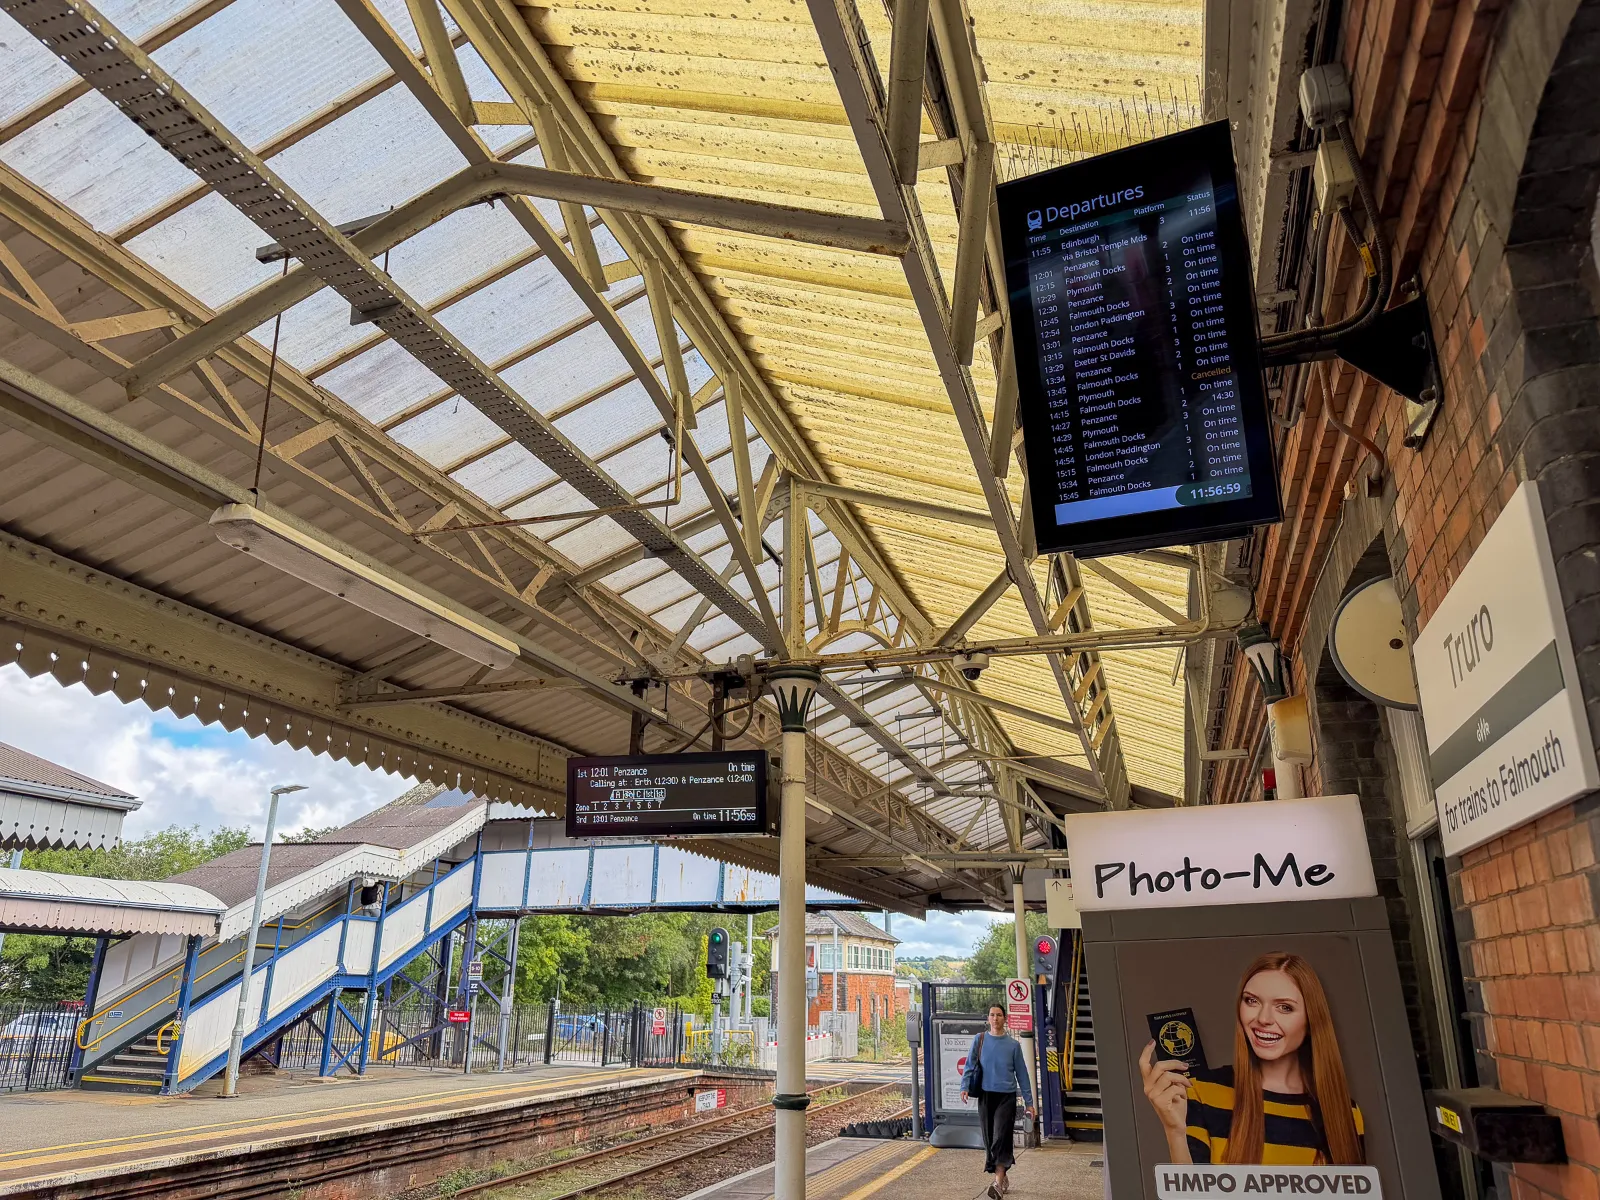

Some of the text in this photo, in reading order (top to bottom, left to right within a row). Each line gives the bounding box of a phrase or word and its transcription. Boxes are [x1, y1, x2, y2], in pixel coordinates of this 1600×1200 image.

[1028, 191, 1210, 243] Time Destination Platform Status
[1046, 185, 1144, 222] Departures
[1031, 246, 1051, 257] 11:55
[1061, 234, 1100, 249] Edinburgh
[1188, 204, 1211, 216] 11:56
[1074, 245, 1099, 258] Bristol
[1100, 239, 1128, 251] Temple
[1130, 234, 1147, 243] Mds
[1034, 270, 1052, 280] 12:01
[1063, 259, 1100, 273] Penzance
[1195, 230, 1214, 240] time
[1035, 281, 1055, 292] 12:15
[1065, 270, 1100, 284] Falmouth
[1102, 265, 1126, 275] Docks
[1196, 243, 1216, 252] time
[1037, 293, 1056, 303] 12:29
[1066, 282, 1102, 297] Plymouth
[1198, 255, 1217, 264] time
[1038, 305, 1058, 315] 12:30
[1067, 295, 1104, 308] Penzance
[1199, 268, 1218, 277] time
[1039, 316, 1059, 327] 12:45
[1069, 306, 1105, 320] Falmouth
[1106, 300, 1130, 311] Docks
[1201, 280, 1220, 289] time
[1040, 328, 1060, 338] 12:54
[1070, 320, 1099, 332] London
[1100, 310, 1145, 325] Paddington
[1202, 292, 1222, 301] time
[1042, 340, 1060, 350] 13:01
[1071, 330, 1108, 343] Penzance
[1204, 305, 1223, 314] time
[1043, 351, 1063, 362] 13:15
[1073, 341, 1109, 355] Falmouth
[1110, 336, 1134, 347] Docks
[1205, 317, 1224, 326] time
[1044, 363, 1064, 373] 13:29
[1074, 356, 1098, 367] Exeter
[1109, 348, 1136, 359] Davids
[1207, 329, 1226, 338] time
[1045, 375, 1065, 385] 13:34
[1075, 366, 1112, 379] Penzance
[1208, 342, 1228, 351] time
[1046, 386, 1066, 396] 13:45
[1076, 377, 1113, 390] Falmouth
[1114, 372, 1138, 383] Docks
[1210, 354, 1230, 363] time
[1048, 365, 1231, 408] 13:54 Plymouth Cancelled
[1049, 409, 1069, 419] 14:15
[1079, 401, 1116, 414] Falmouth
[1117, 396, 1141, 406] Docks
[1213, 379, 1232, 388] time
[1050, 421, 1070, 431] 14:27
[1080, 414, 1117, 425] Penzance
[1212, 390, 1234, 400] 14:30
[1052, 433, 1072, 443] 14:29
[1082, 424, 1118, 438] Plymouth
[1216, 404, 1235, 412] time
[1053, 444, 1074, 454] 14:45
[1083, 436, 1120, 449] Falmouth
[1121, 432, 1145, 442] Docks
[1218, 416, 1237, 425] time
[1054, 456, 1075, 466] 14:54
[1085, 451, 1114, 461] London
[1115, 442, 1160, 455] Paddington
[1219, 429, 1238, 437] time
[1056, 468, 1076, 477] 15:15
[1086, 460, 1122, 472] Falmouth
[1124, 456, 1148, 466] Docks
[1057, 479, 1078, 489] 15:34
[1087, 473, 1124, 484] Penzance
[1059, 491, 1079, 500] 15:45
[1089, 484, 1125, 495] Falmouth
[1127, 480, 1151, 490] Docks
[1224, 466, 1243, 474] time
[1190, 482, 1241, 499] 11:56:59
[1444, 604, 1493, 688] Truro
[578, 763, 755, 777] 1st 12:01 Penzance On time
[590, 780, 615, 788] Calling
[1445, 730, 1565, 833] for trains to Falmouth
[1095, 852, 1335, 899] Photo-Me
[1163, 1173, 1372, 1194] HMPO APPROVED
